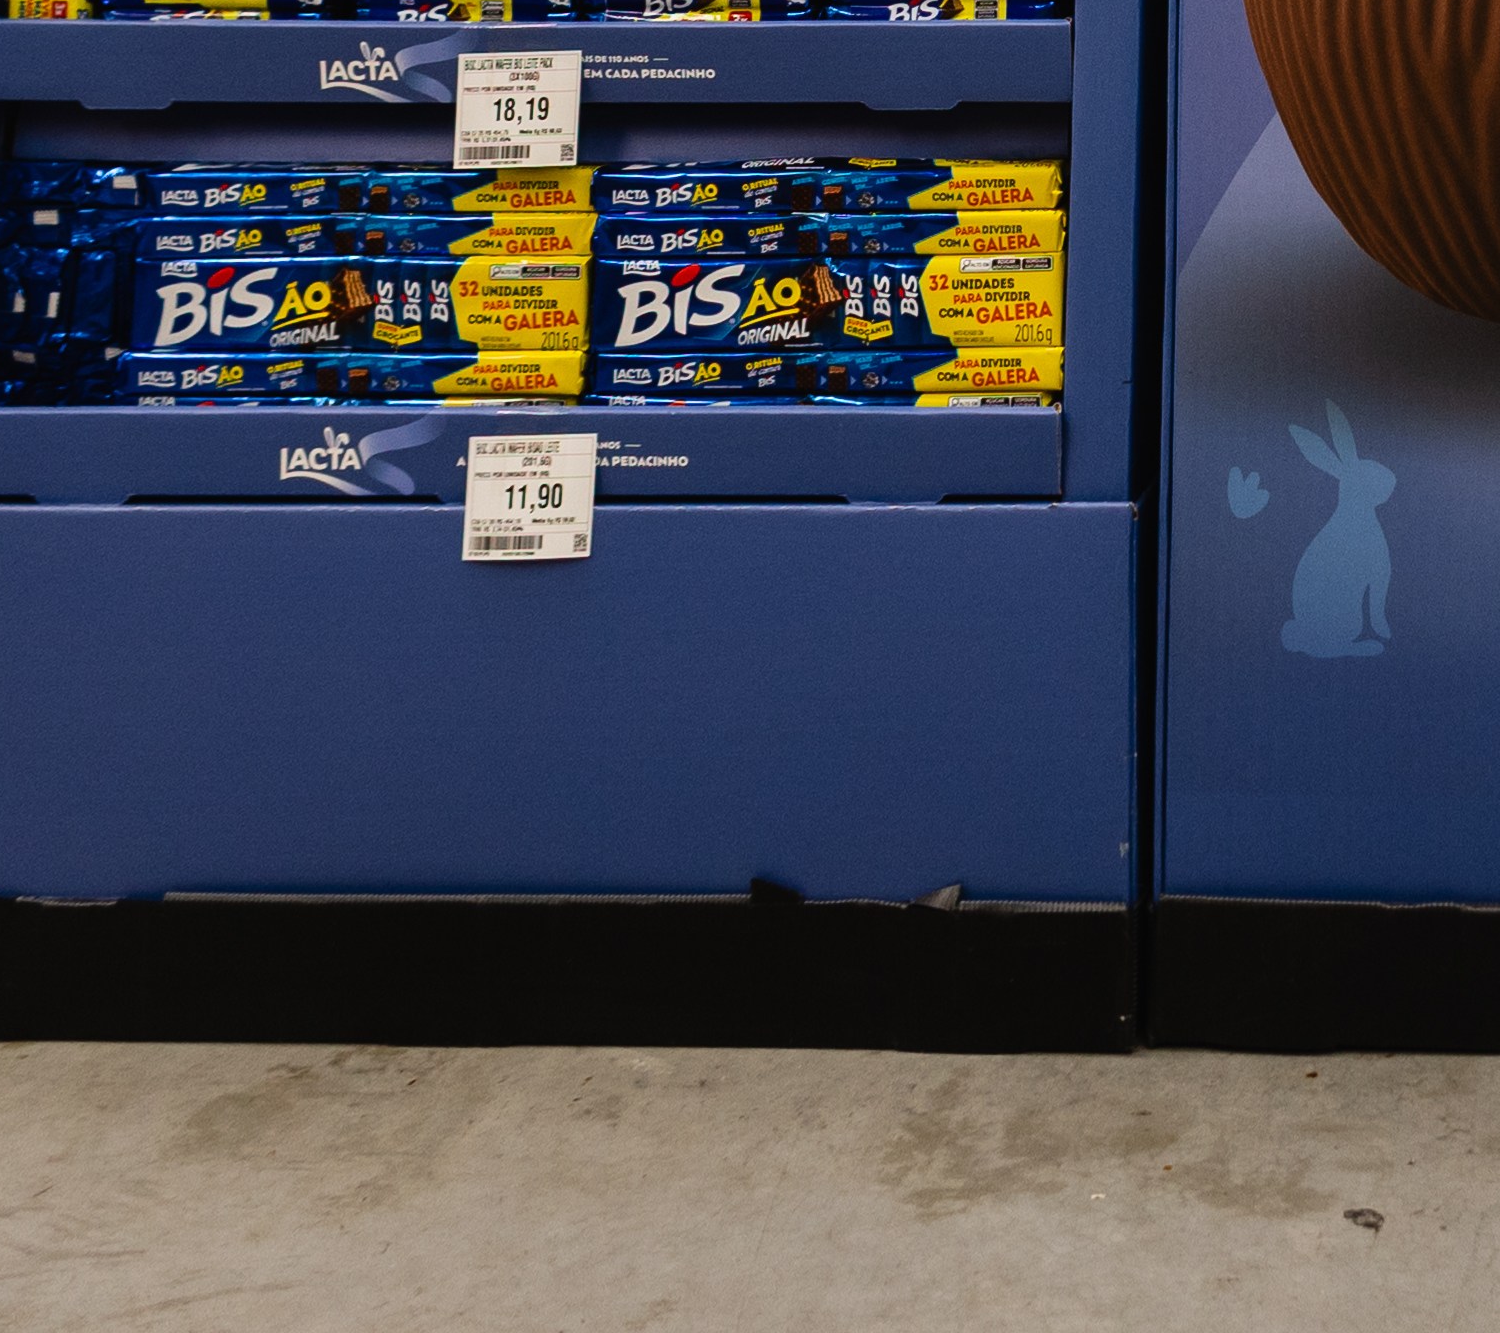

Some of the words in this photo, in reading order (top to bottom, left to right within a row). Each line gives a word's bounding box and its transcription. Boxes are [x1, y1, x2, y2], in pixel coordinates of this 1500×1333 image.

[320, 58, 399, 90] LACTA
[494, 97, 549, 125] 18,19
[966, 186, 1033, 207] GALERA
[161, 262, 198, 277] LACTA
[458, 281, 480, 297] 32
[482, 285, 543, 297] UNIDADES
[483, 299, 511, 311] PARA
[513, 298, 558, 310] DIVIDIR
[975, 301, 1053, 324] GALERA
[468, 314, 491, 326] COM
[494, 315, 502, 326] A
[503, 310, 580, 331] GALERA
[737, 318, 810, 346] ORIGINAL
[269, 321, 340, 347] ORIGINAL
[280, 446, 361, 480] LACTA
[456, 457, 466, 466] A
[612, 456, 689, 467] PEDACINHO
[505, 483, 563, 513] 11,90
